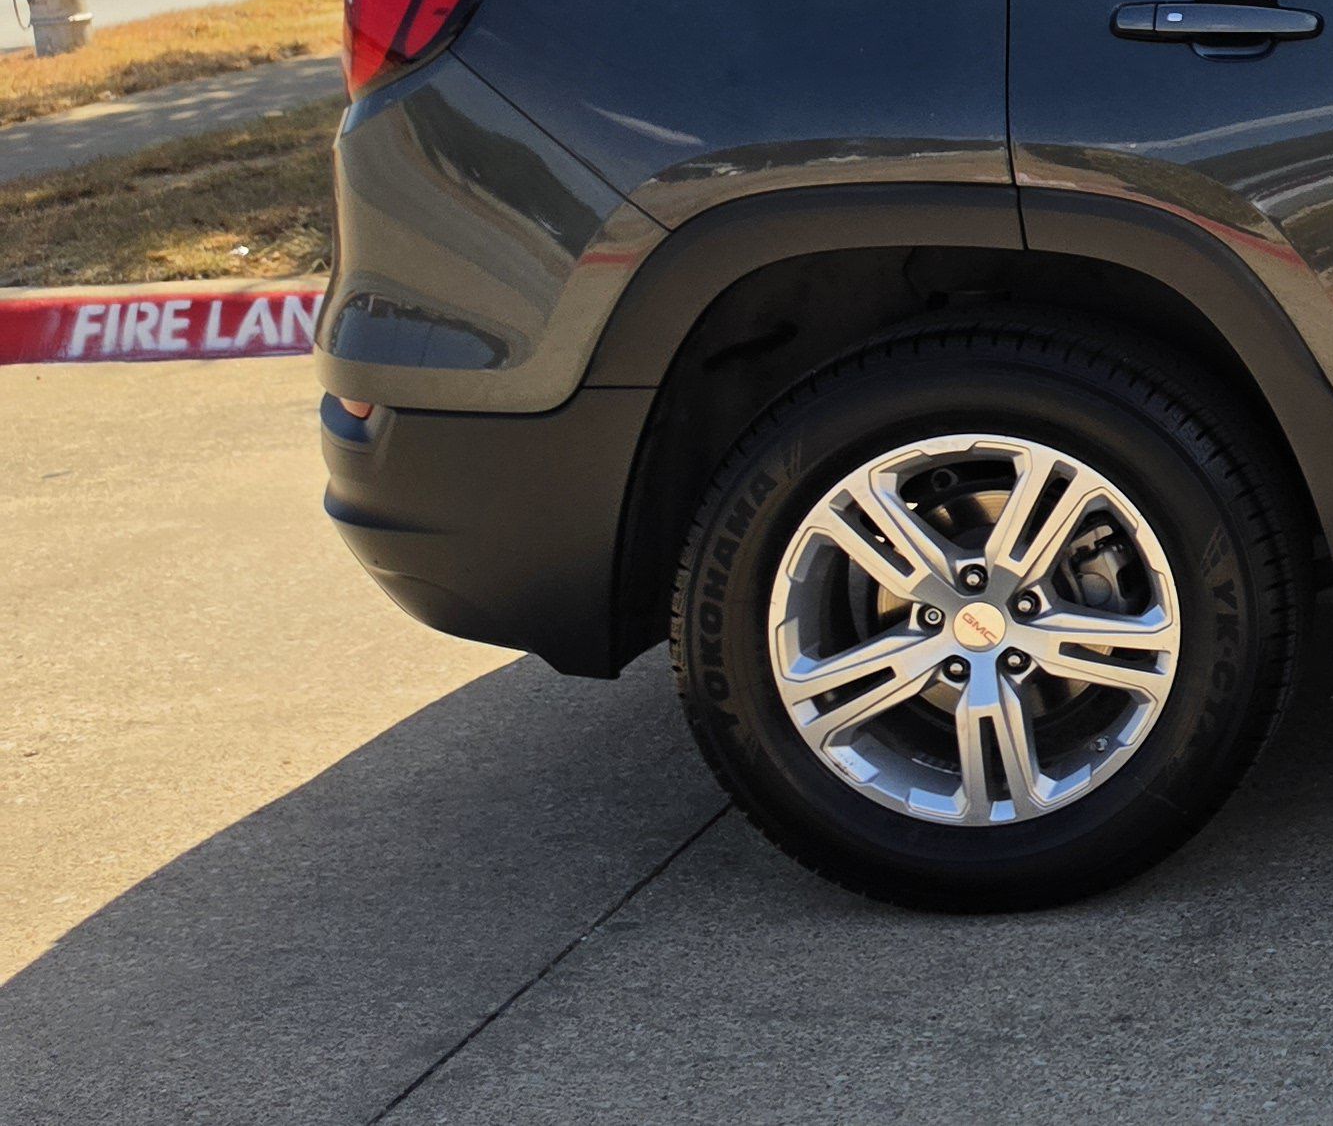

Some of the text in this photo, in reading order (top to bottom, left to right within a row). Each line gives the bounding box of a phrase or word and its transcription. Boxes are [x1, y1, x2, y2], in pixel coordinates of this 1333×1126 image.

[68, 299, 191, 357] FIRE
[697, 472, 778, 740] YOKOHAMA
[962, 612, 998, 645] GMC
